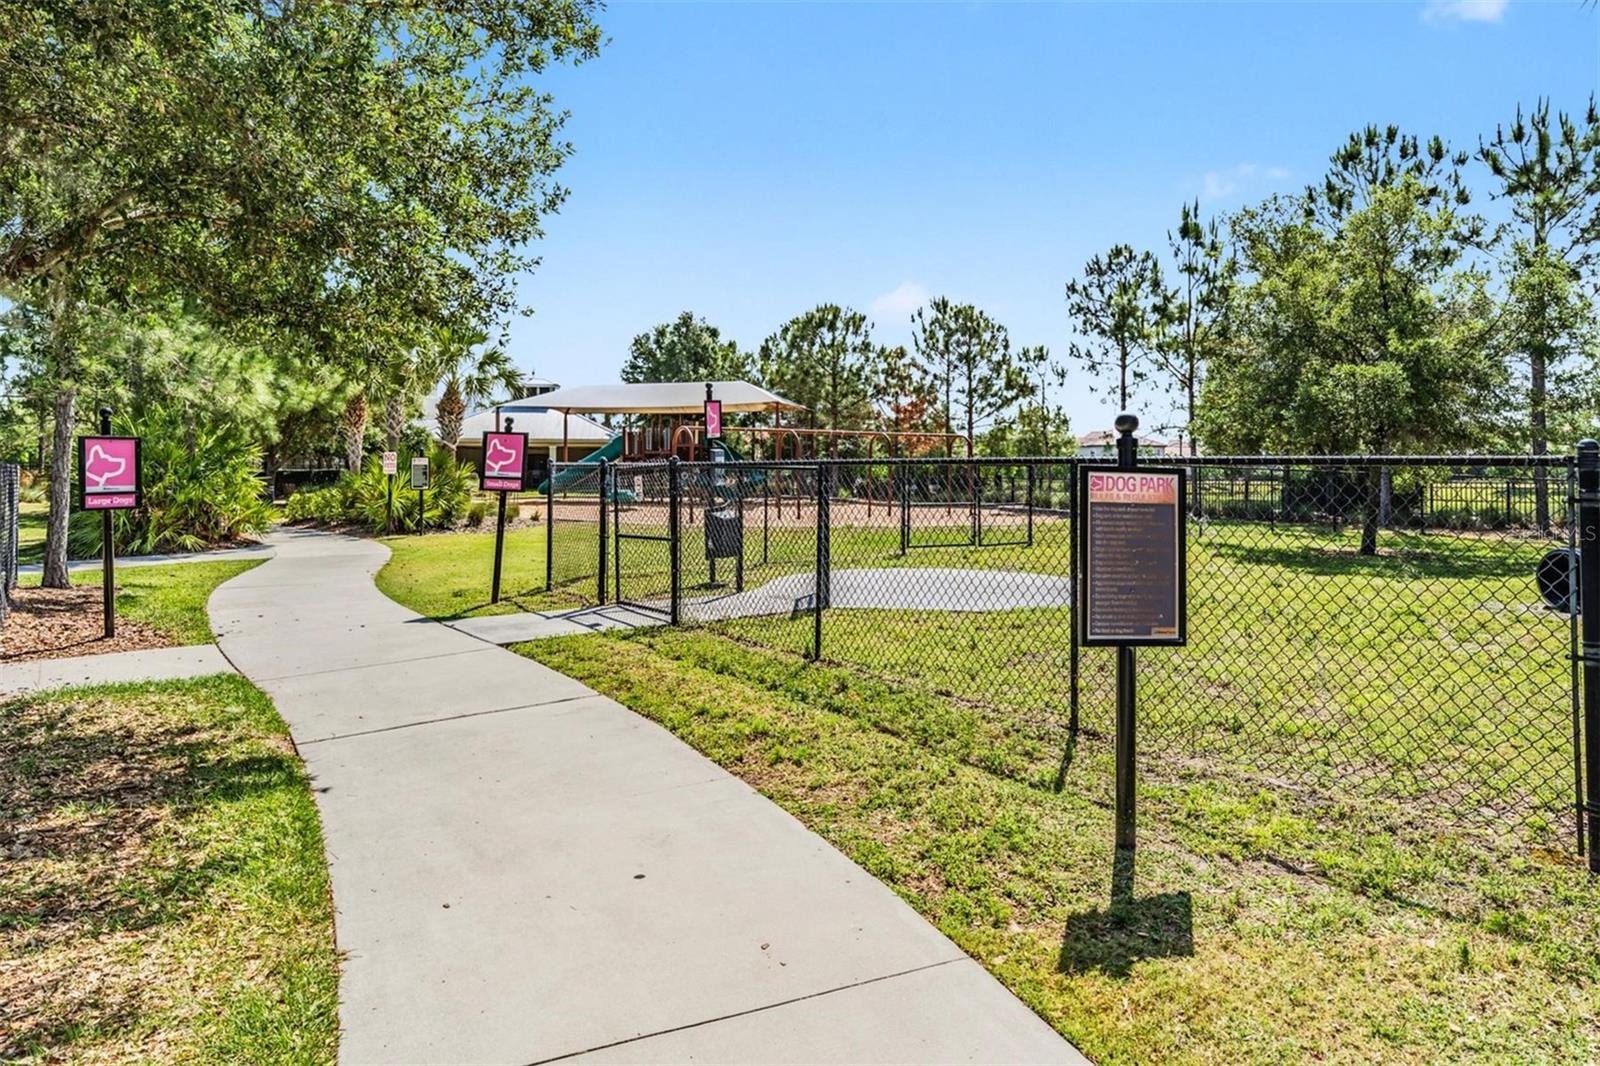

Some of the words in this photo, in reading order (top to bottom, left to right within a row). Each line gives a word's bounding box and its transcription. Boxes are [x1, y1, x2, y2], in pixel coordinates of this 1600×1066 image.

[384, 454, 397, 462] NO
[1105, 475, 1137, 492] DOG
[1140, 477, 1174, 494] PARK
[88, 497, 111, 505] Large
[113, 496, 132, 506] Dogs
